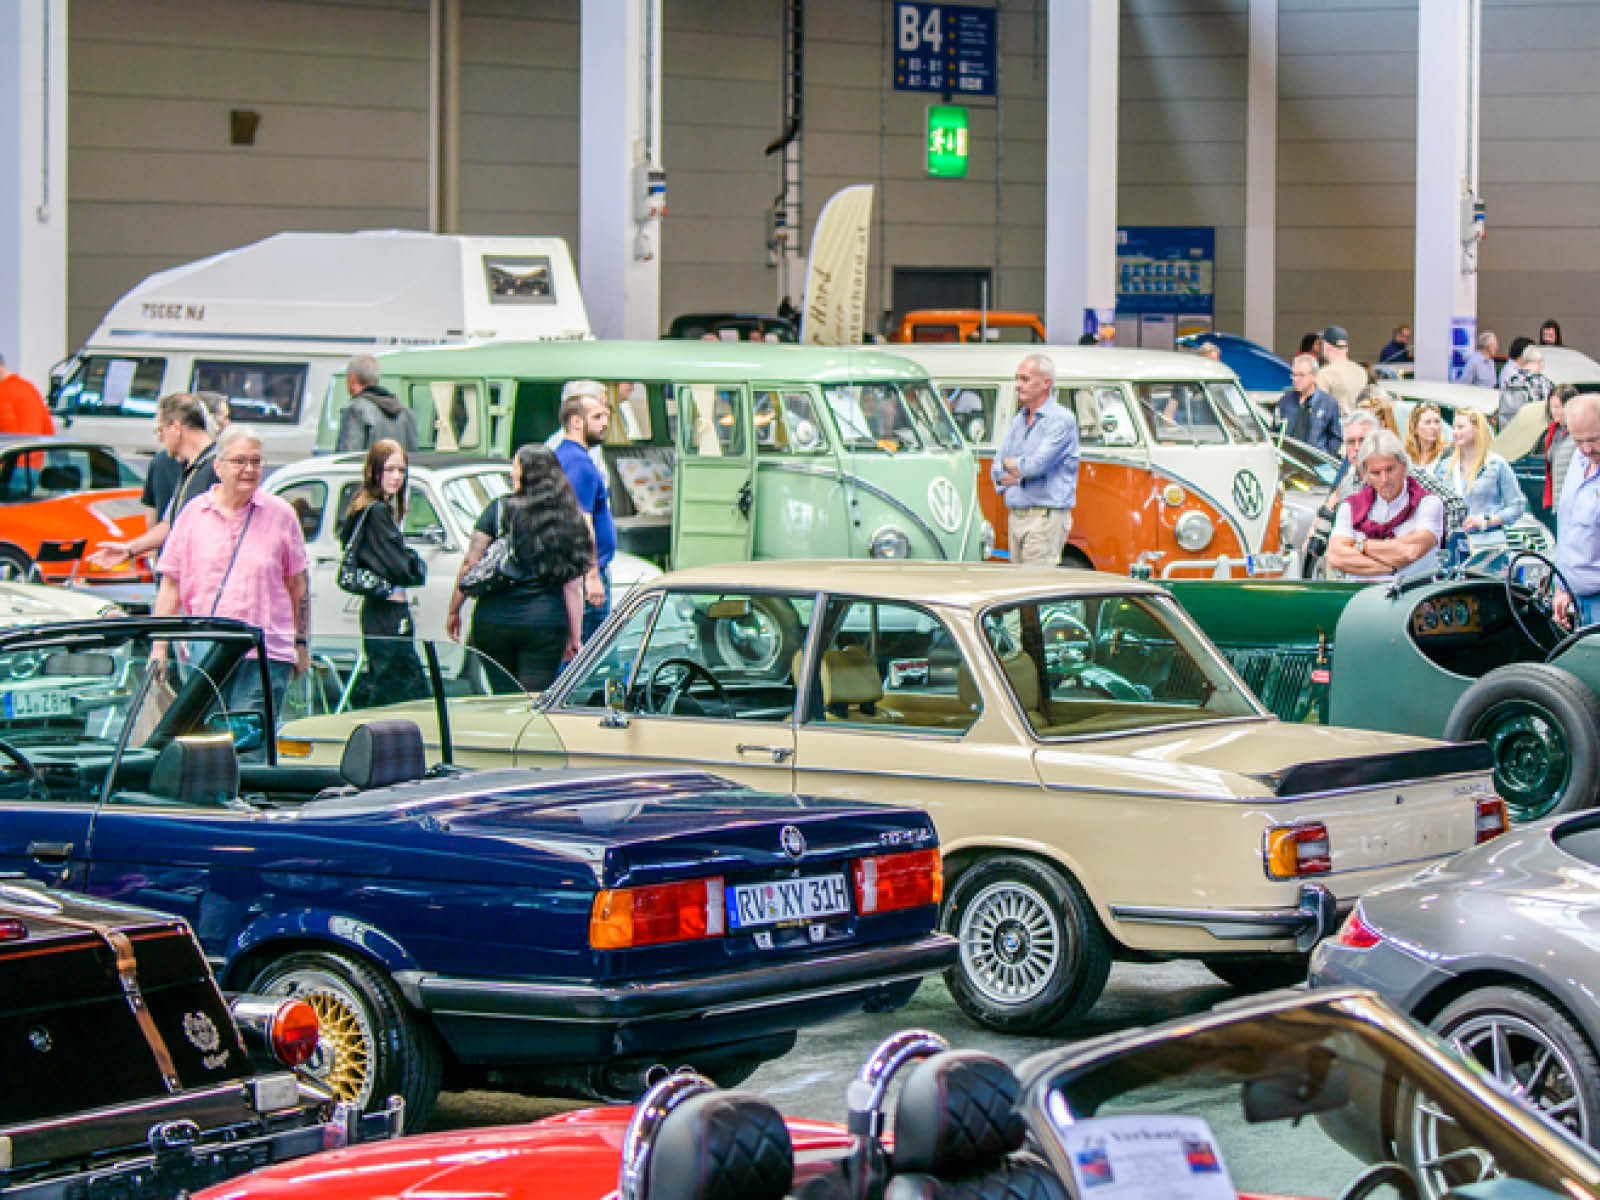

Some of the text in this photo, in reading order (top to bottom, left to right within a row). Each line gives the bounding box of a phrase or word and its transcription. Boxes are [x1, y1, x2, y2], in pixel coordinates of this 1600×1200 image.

[899, 6, 943, 51] B4
[737, 877, 847, 921] RV XY 31H
